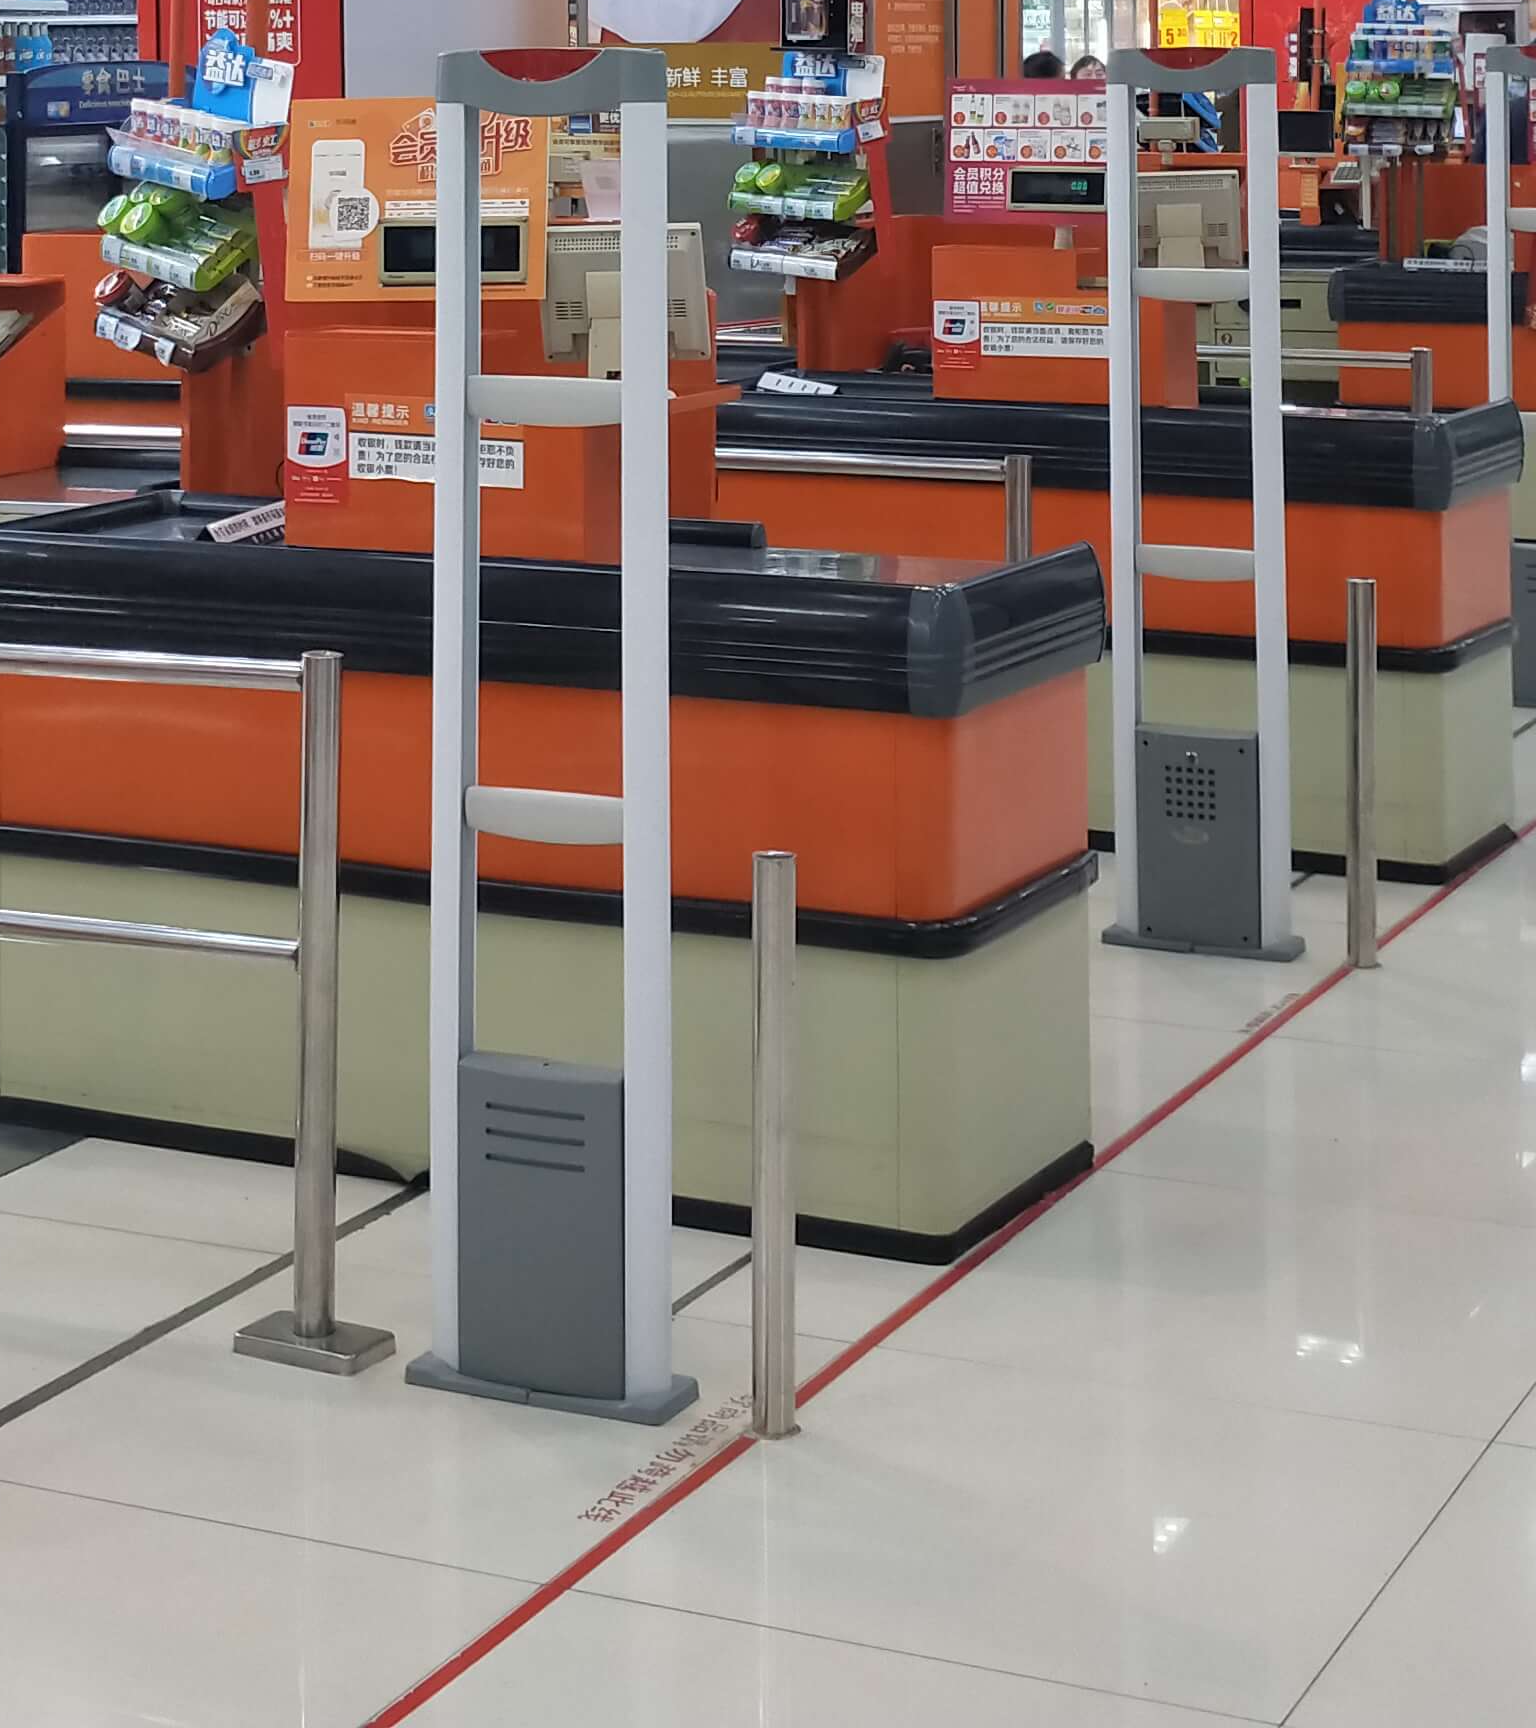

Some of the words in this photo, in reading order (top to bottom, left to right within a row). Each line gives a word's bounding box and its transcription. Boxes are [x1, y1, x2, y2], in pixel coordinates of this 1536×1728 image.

[203, 50, 246, 87] 益达
[665, 66, 702, 89] 新鲜
[711, 66, 749, 89] 丰富
[793, 53, 837, 78] 益达
[81, 67, 146, 96] 零食巴士
[390, 113, 532, 174] 会员升级
[953, 167, 1005, 181] 会员积分
[952, 181, 1005, 195] 超值兑换
[351, 402, 410, 419] 温馨提示
